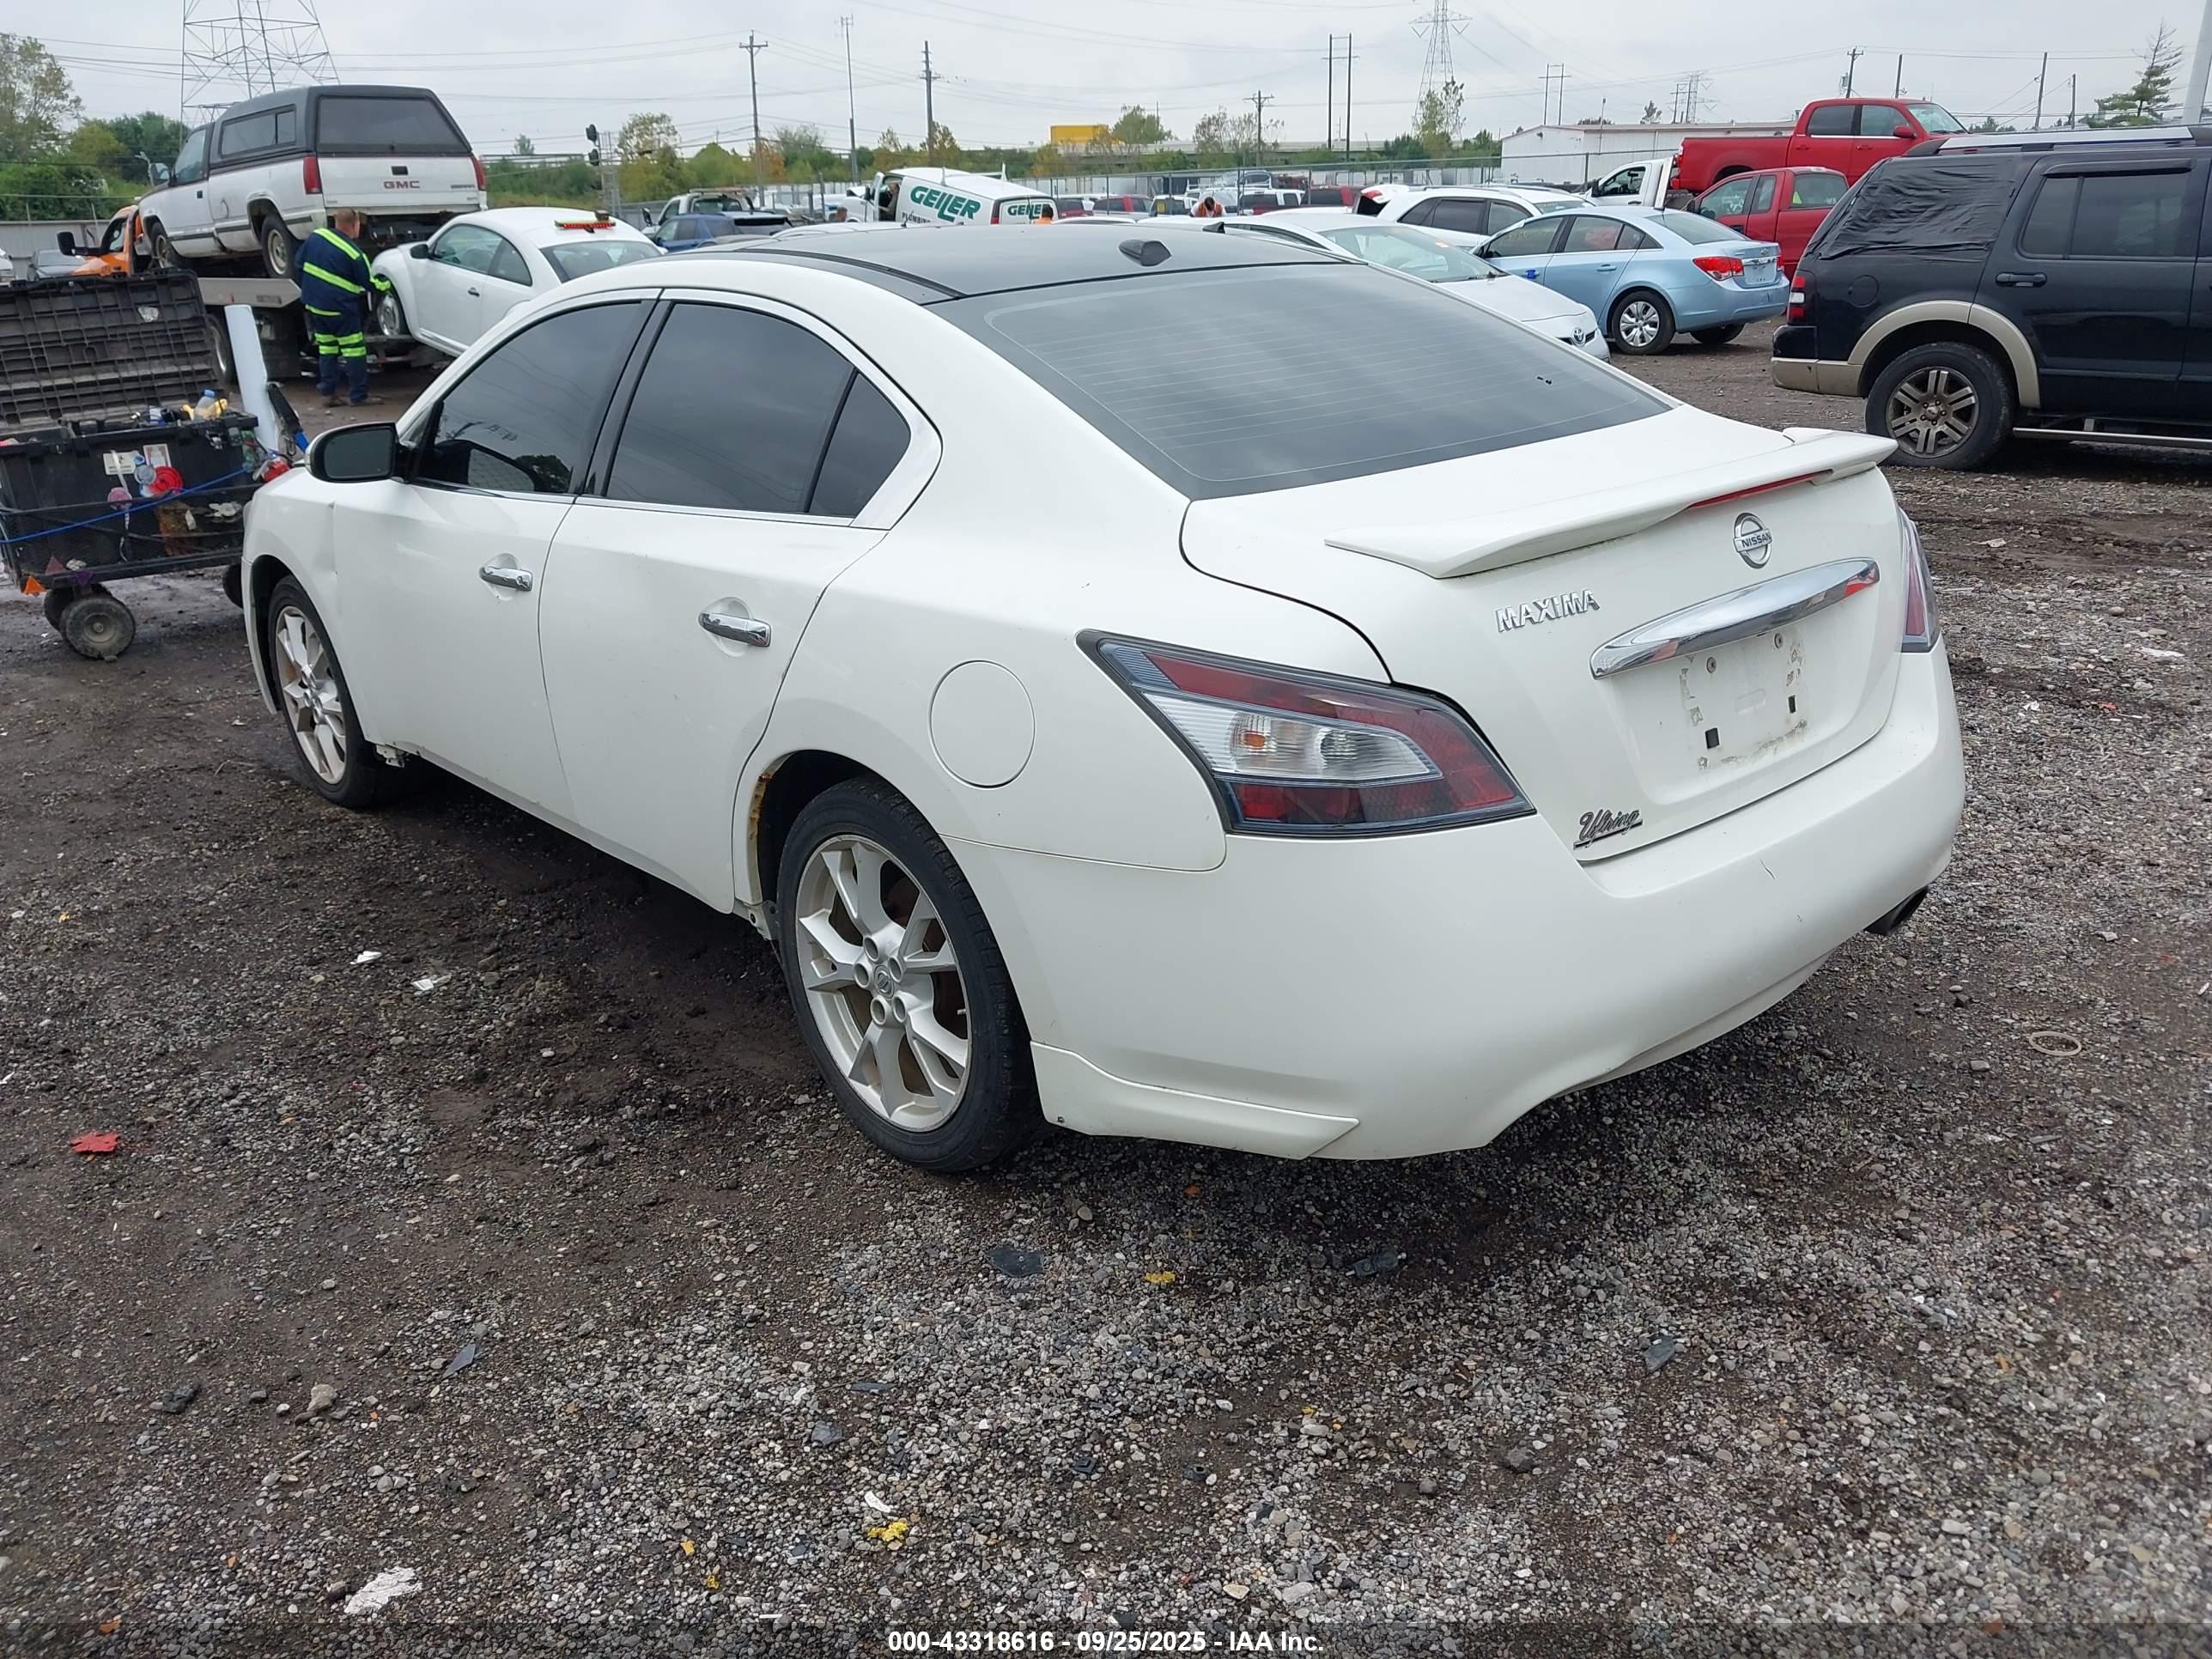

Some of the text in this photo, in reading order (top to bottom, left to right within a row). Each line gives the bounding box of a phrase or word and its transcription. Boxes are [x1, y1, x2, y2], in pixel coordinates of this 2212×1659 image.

[383, 180, 420, 190] GMC
[910, 185, 981, 222] GEILER
[1007, 204, 1045, 220] GEILE
[1741, 532, 1771, 548] NISSAN
[1496, 588, 1601, 633] MAXIMA
